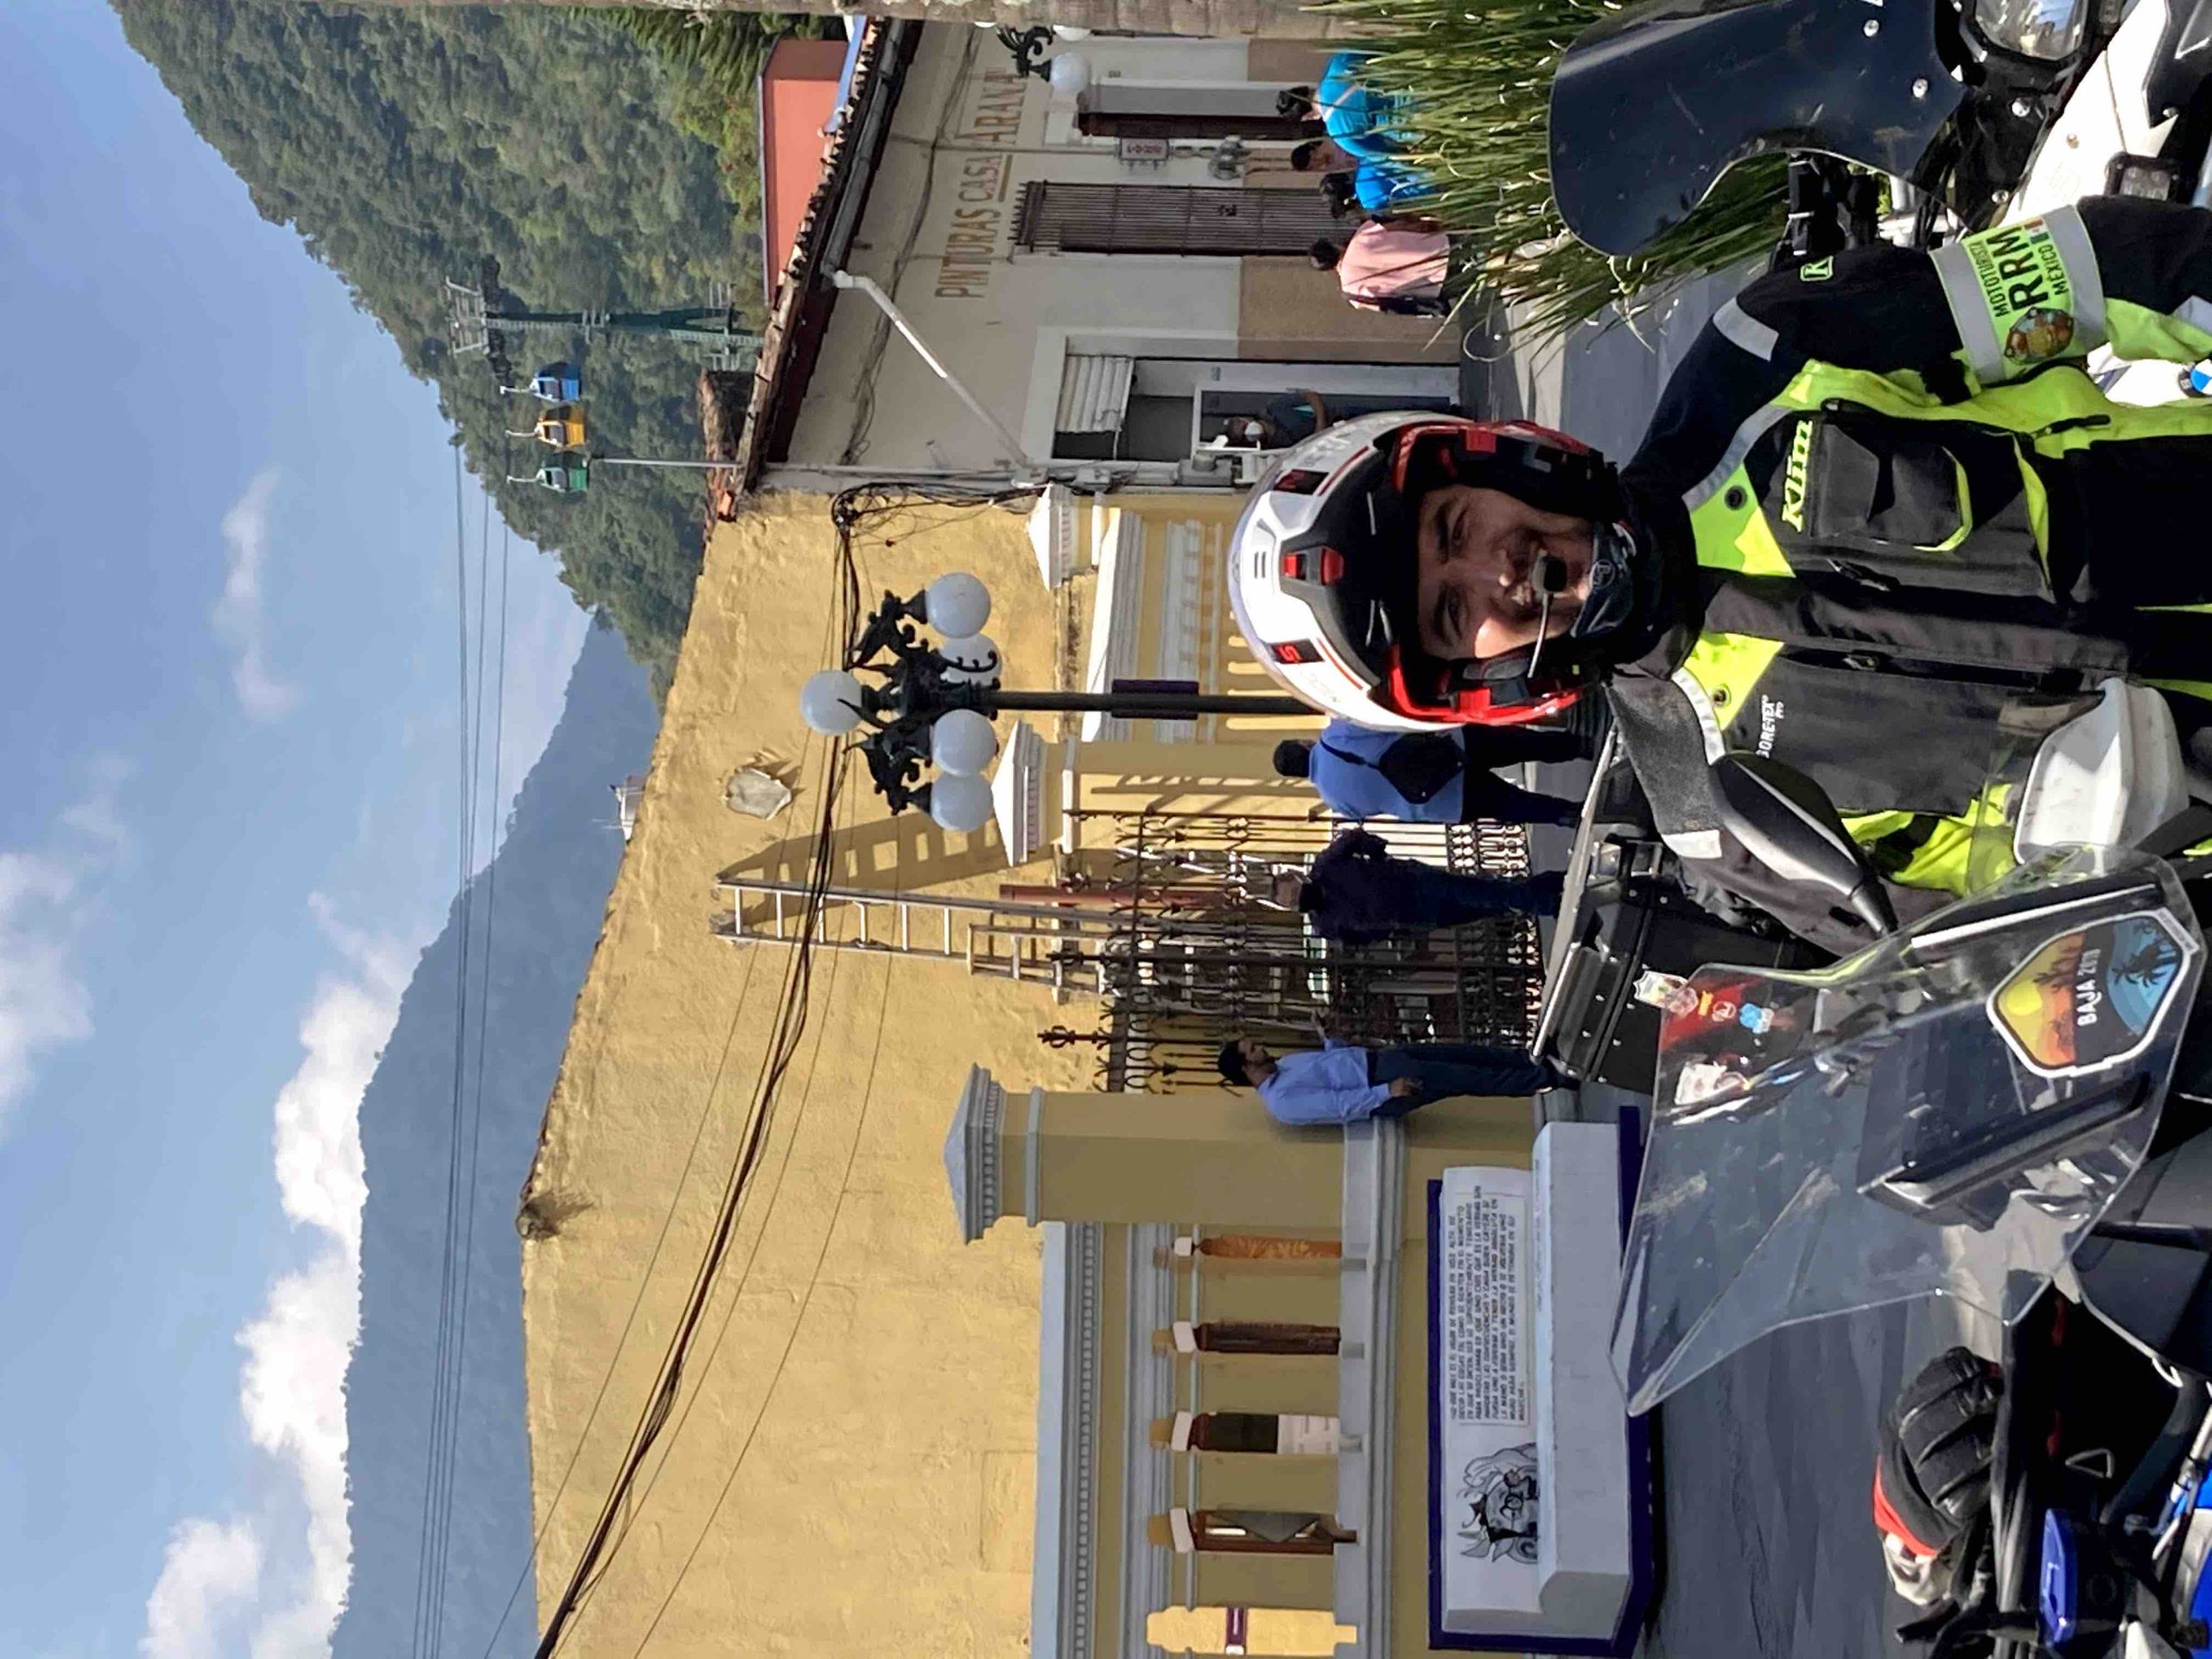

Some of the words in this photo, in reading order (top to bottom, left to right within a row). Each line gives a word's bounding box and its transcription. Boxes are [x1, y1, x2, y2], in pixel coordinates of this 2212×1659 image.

[957, 154, 1003, 202] CASA
[934, 209, 1001, 298] PINTURAS
[1986, 226, 2049, 311] RRM
[2075, 980, 2101, 1027] BAJA
